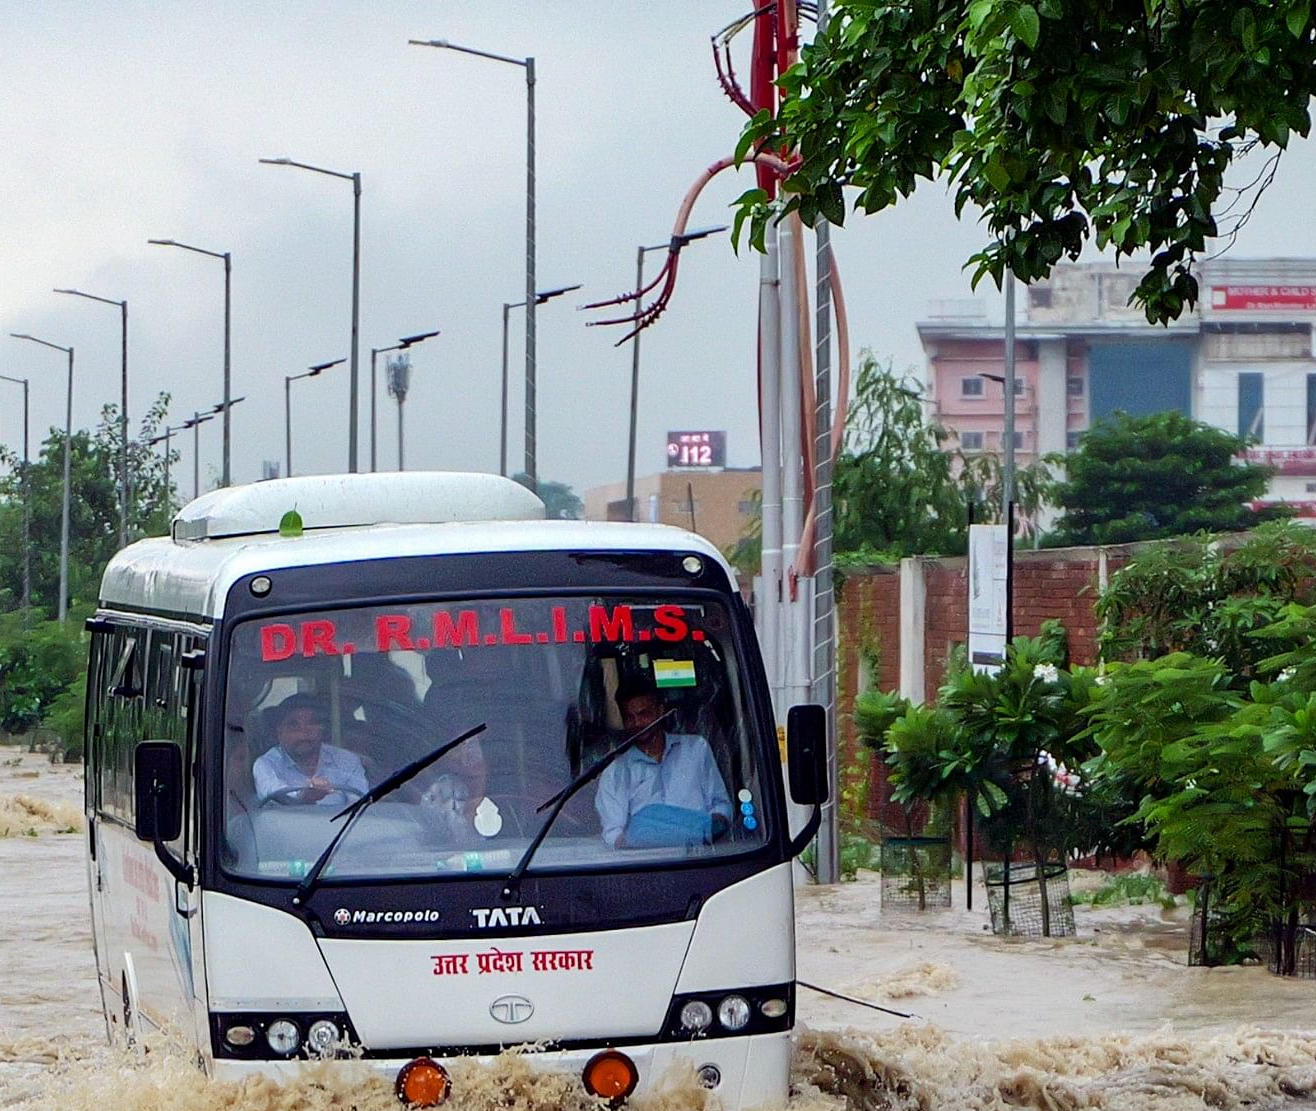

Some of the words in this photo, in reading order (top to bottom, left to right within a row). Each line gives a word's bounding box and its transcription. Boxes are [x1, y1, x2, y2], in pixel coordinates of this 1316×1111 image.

[679, 445, 712, 465] 112
[260, 619, 355, 661] DR.
[375, 604, 705, 651] R.M.L.I.M.S.
[352, 909, 440, 924] Marcopolo
[472, 907, 542, 928] TATA
[430, 953, 469, 976] उत्तर
[476, 946, 523, 975] प्रदेश
[530, 950, 594, 972] सरकार
